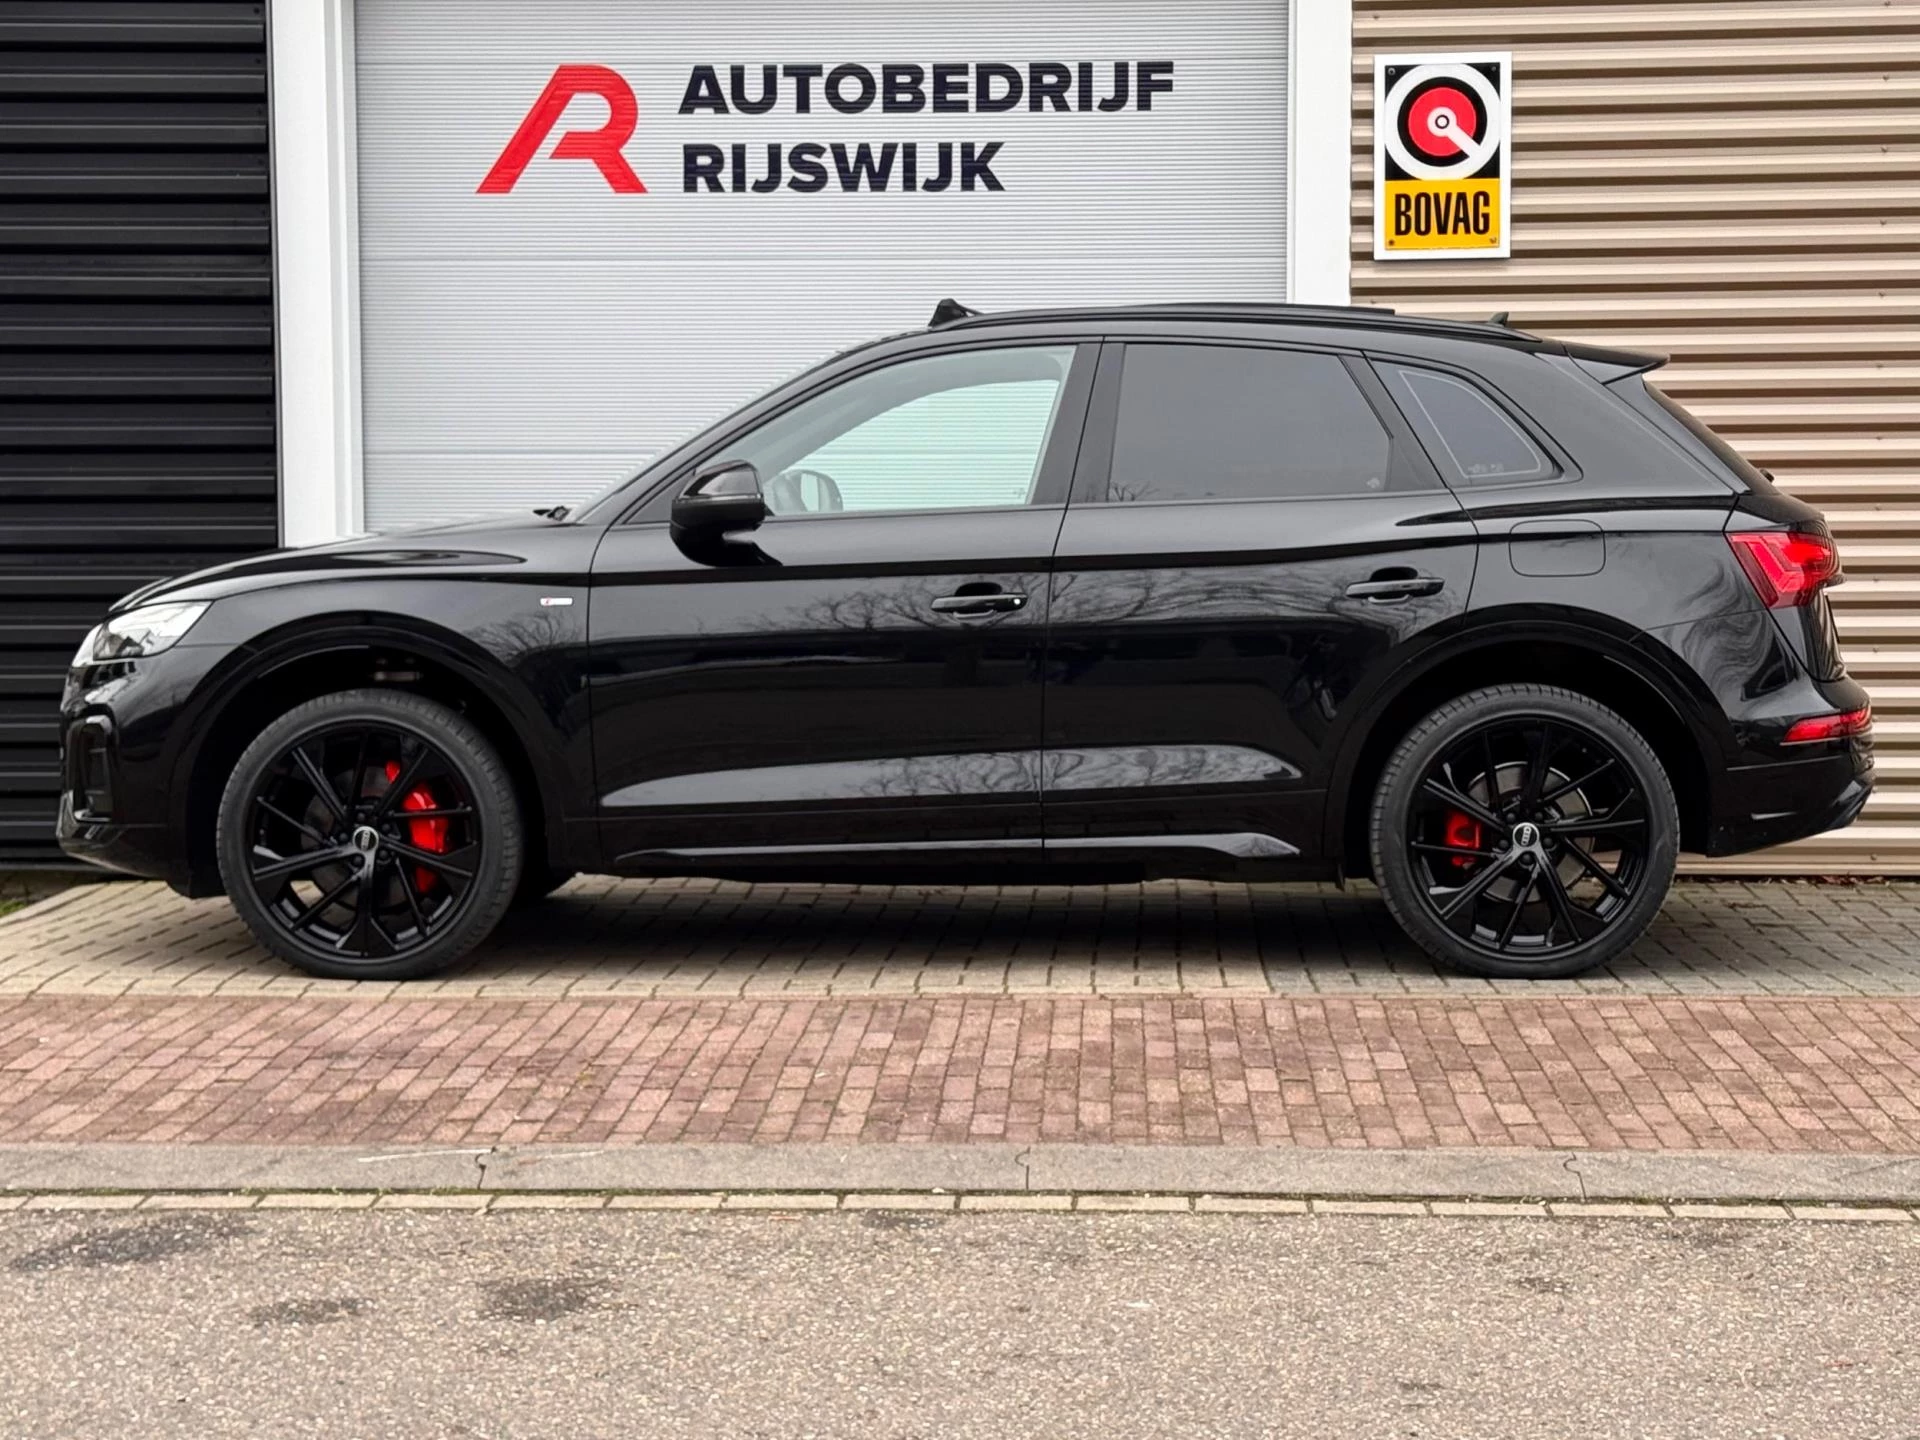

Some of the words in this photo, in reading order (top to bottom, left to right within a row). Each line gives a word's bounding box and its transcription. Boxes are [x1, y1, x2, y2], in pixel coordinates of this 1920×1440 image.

[678, 61, 1174, 115] AUTOBEDRIJF
[683, 141, 1006, 193] RIJSWIJK
[1394, 191, 1490, 236] BOVAG
